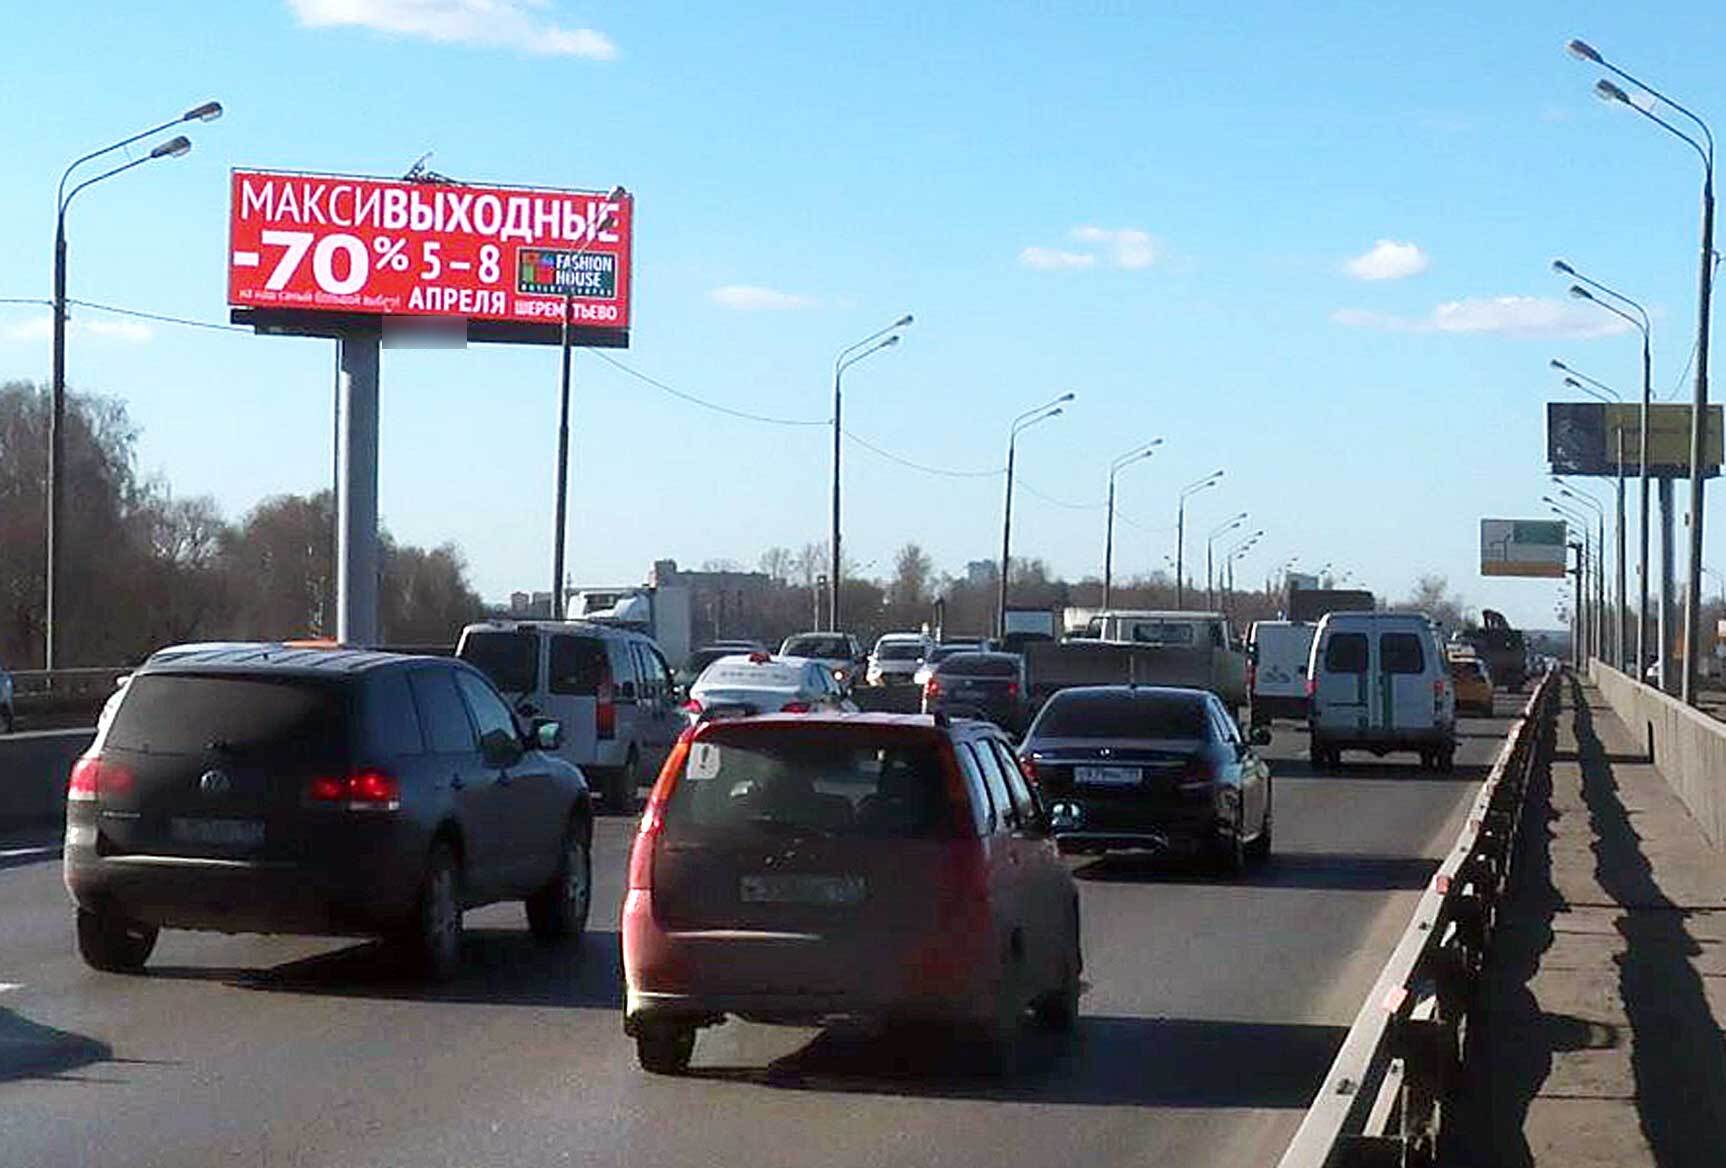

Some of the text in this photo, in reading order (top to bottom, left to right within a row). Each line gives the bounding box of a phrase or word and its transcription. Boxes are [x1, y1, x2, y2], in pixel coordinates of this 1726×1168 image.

[240, 180, 620, 243] МАКСИВЫХОДНЫЕ
[555, 253, 612, 272] FASHION
[555, 270, 602, 287] HOUSE
[408, 286, 505, 314] АПРЕЛЯ
[514, 299, 618, 321] ШЕРЕМТЬЕВО
